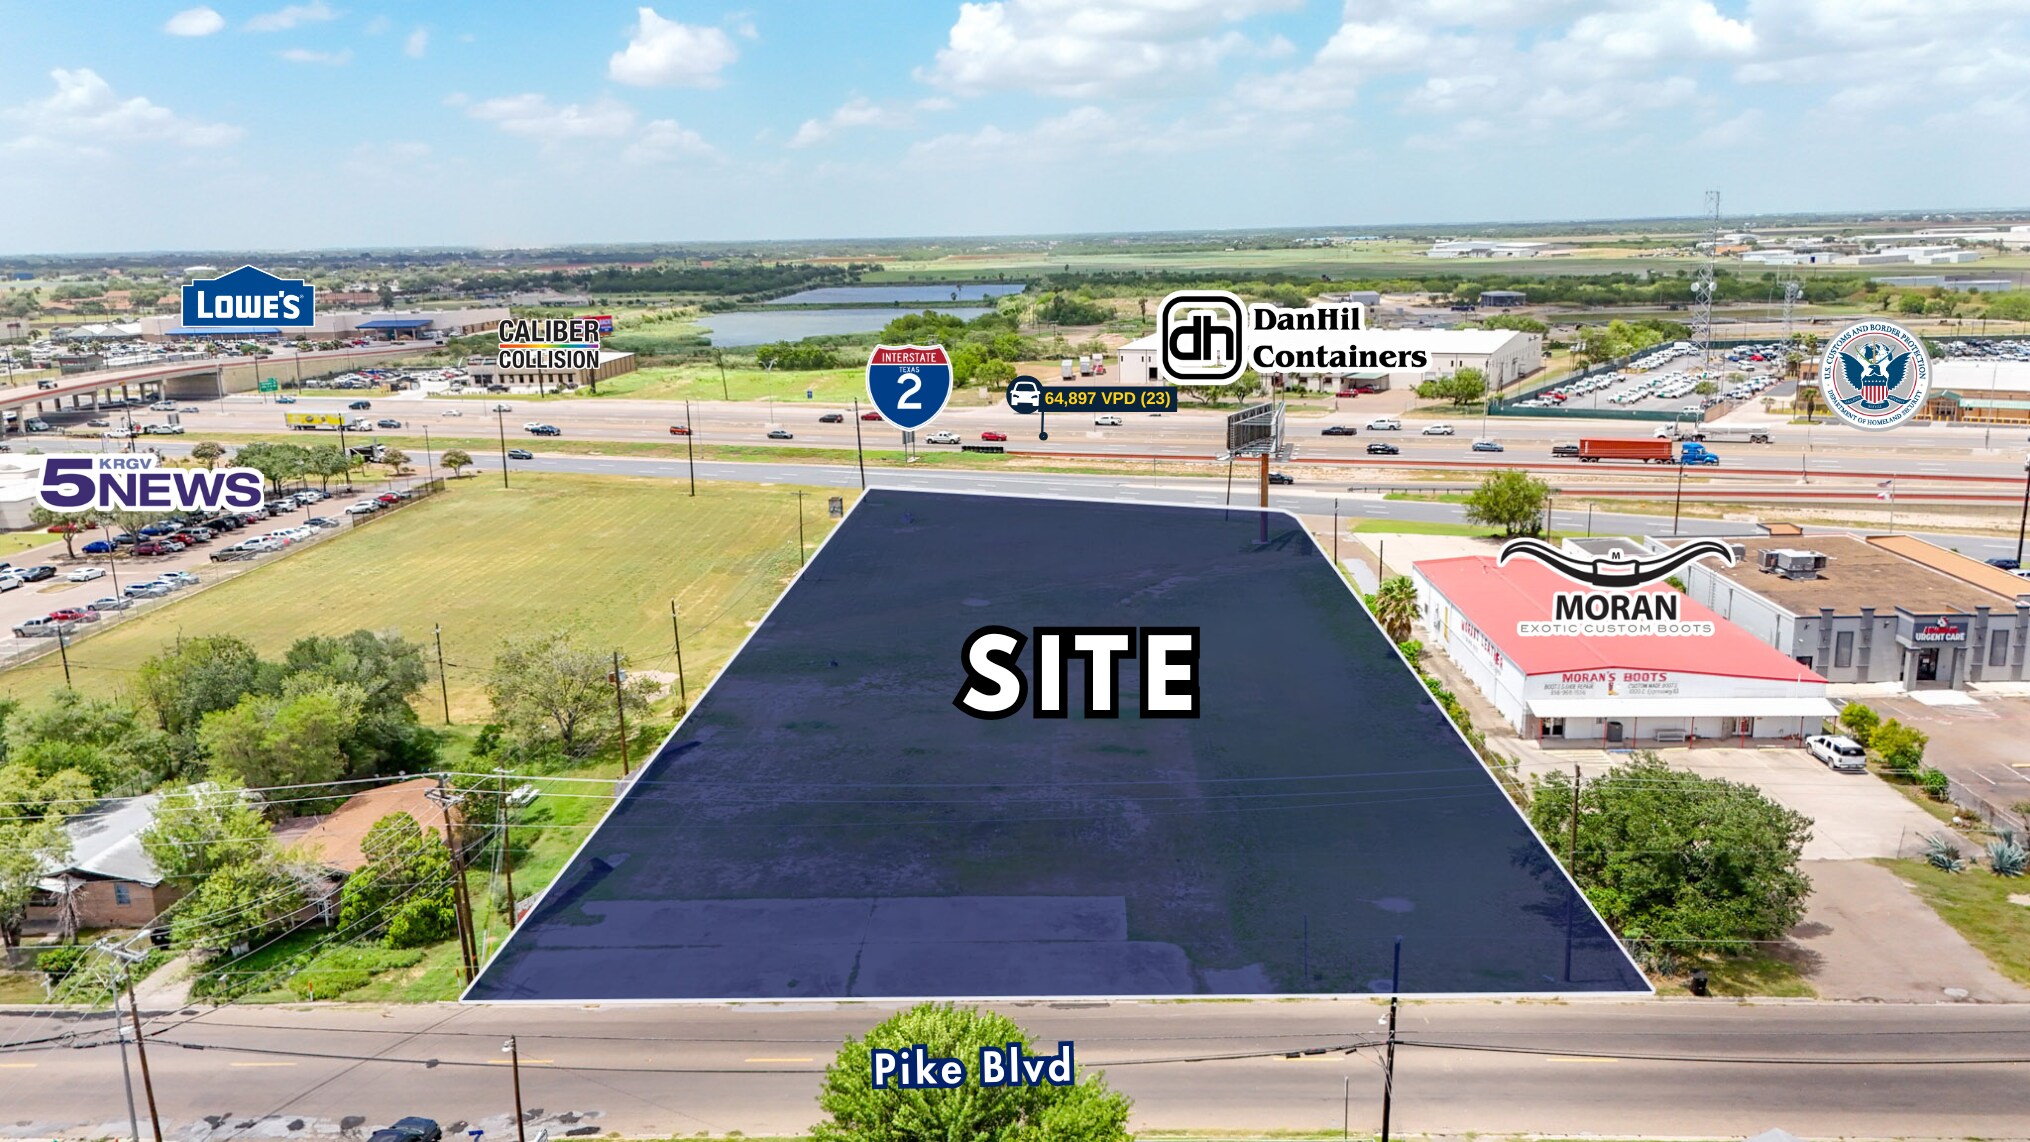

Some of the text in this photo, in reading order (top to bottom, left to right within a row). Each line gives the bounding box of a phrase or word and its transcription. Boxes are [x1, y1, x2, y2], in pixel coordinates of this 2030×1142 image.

[1915, 632, 1966, 641] URGENT CARE
[1562, 671, 1668, 683] MORAN'S BOOTS
